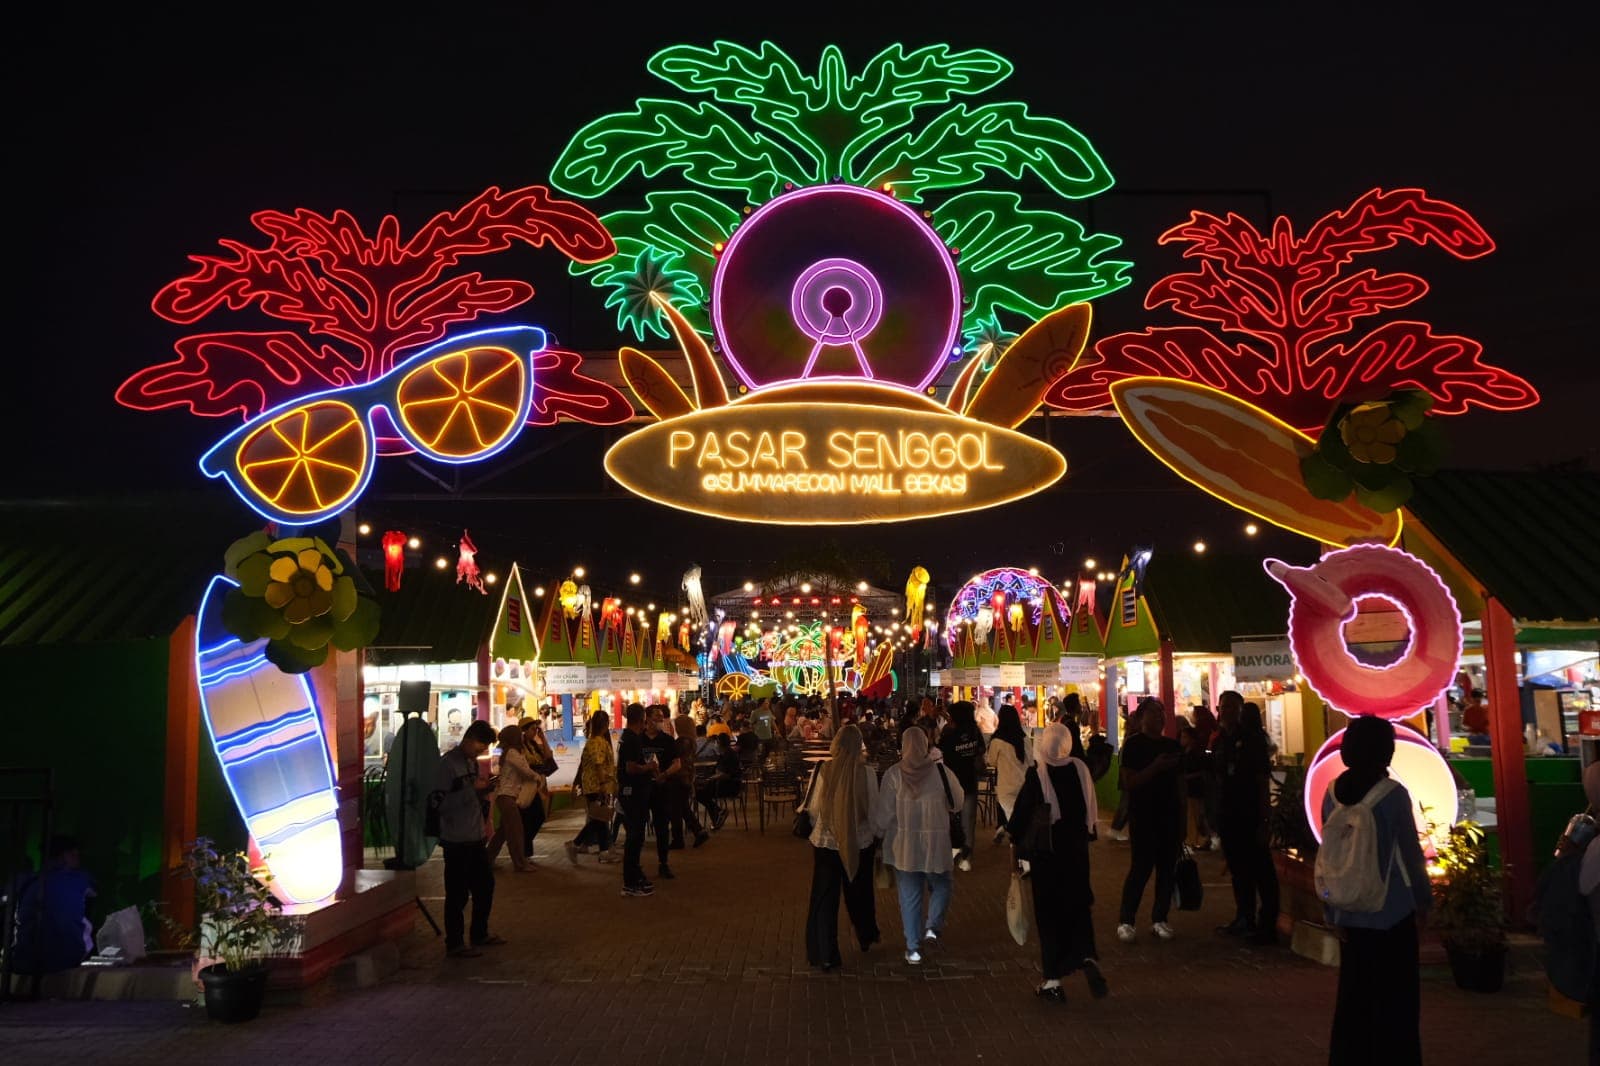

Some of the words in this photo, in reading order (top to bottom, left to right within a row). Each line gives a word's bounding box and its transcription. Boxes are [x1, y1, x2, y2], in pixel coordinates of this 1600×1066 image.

[669, 430, 809, 469] PASAR
[827, 430, 1006, 470] SENGGOL
[702, 472, 845, 493] @SUMMARECON
[850, 472, 902, 494] MALL
[904, 472, 967, 494] BEKASI
[1235, 654, 1291, 666] MAYORA
